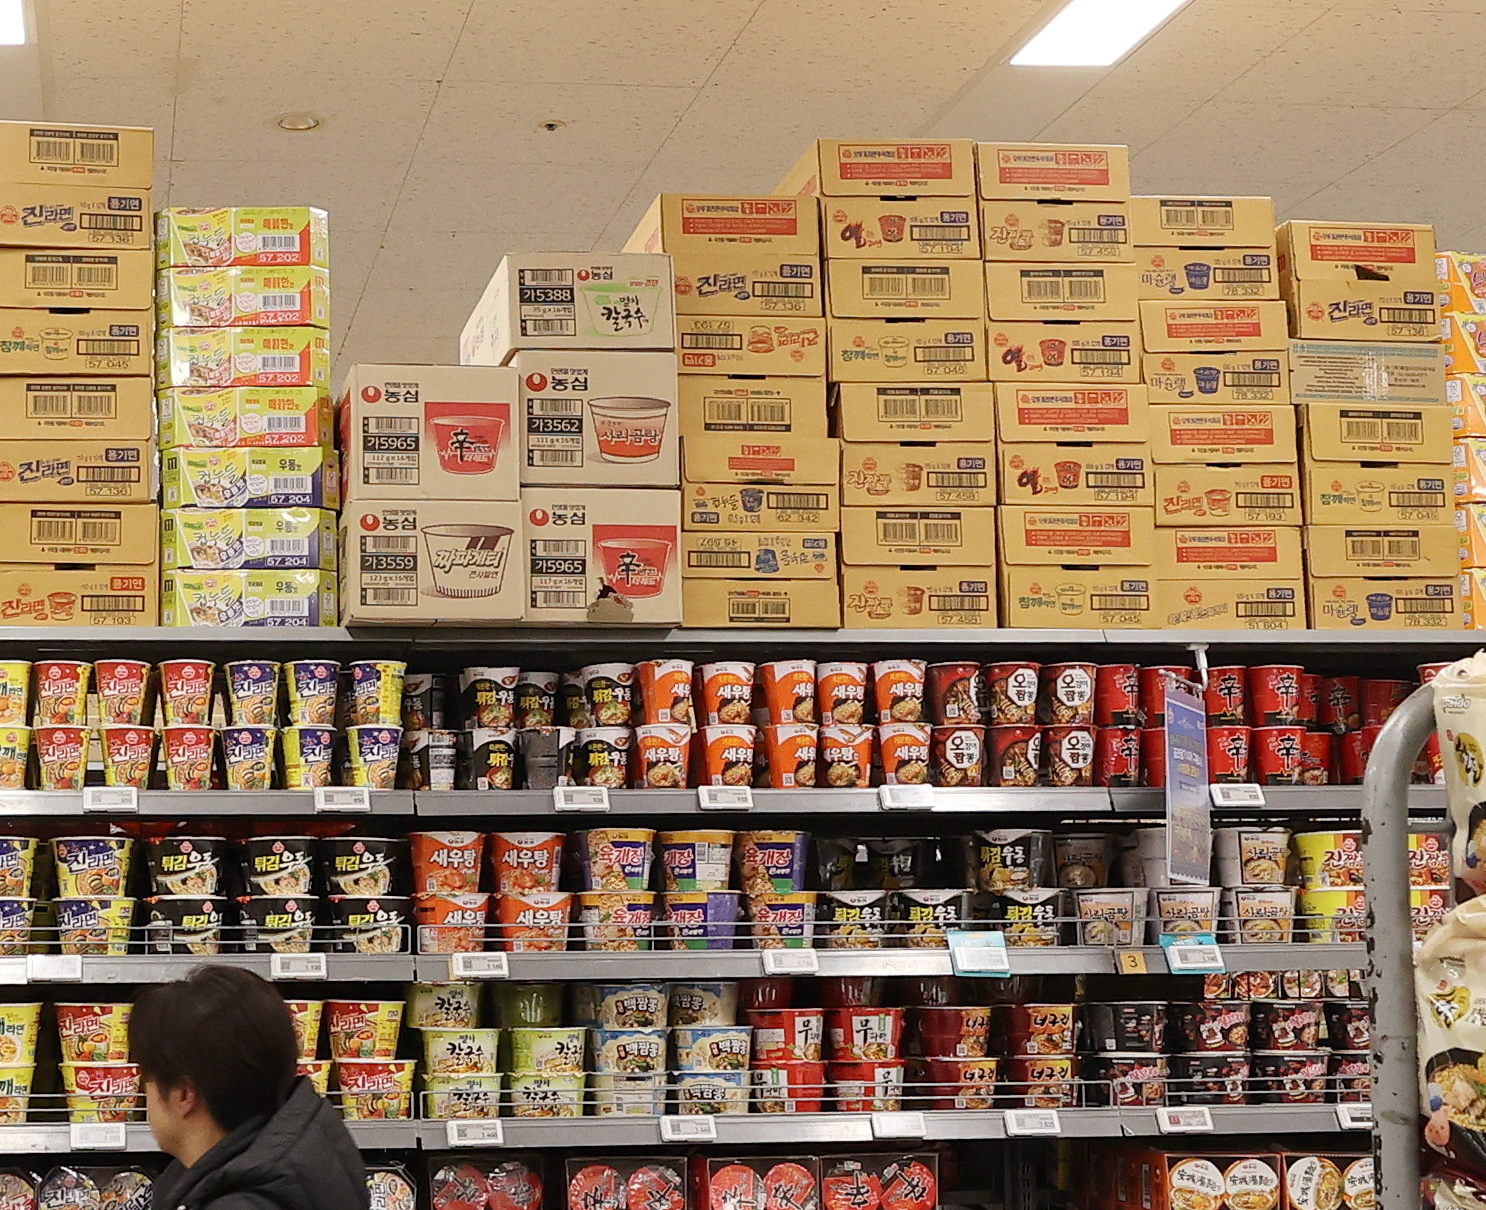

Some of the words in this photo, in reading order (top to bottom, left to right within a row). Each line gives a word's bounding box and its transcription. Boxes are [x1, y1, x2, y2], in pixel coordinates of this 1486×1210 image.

[523, 289, 571, 302] 가5388
[551, 376, 588, 391] 농심
[384, 390, 419, 403] 농심
[531, 418, 580, 432] 가3562
[367, 437, 416, 450] 가5965
[450, 430, 475, 463] 辛
[382, 515, 418, 531] 농심
[551, 511, 587, 526] 농심
[365, 556, 414, 570] 가3559
[434, 548, 504, 574] 짜파게티
[534, 560, 583, 574] 가5965
[617, 551, 641, 587] 辛
[1217, 673, 1241, 701] 辛
[1278, 674, 1299, 700] 辛
[430, 848, 477, 868] 새우탕
[502, 848, 549, 868] 새우탕
[598, 845, 644, 866] 육개장
[743, 845, 791, 867] 육개장
[516, 907, 562, 927] 새우탕
[1127, 954, 1137, 968] 3
